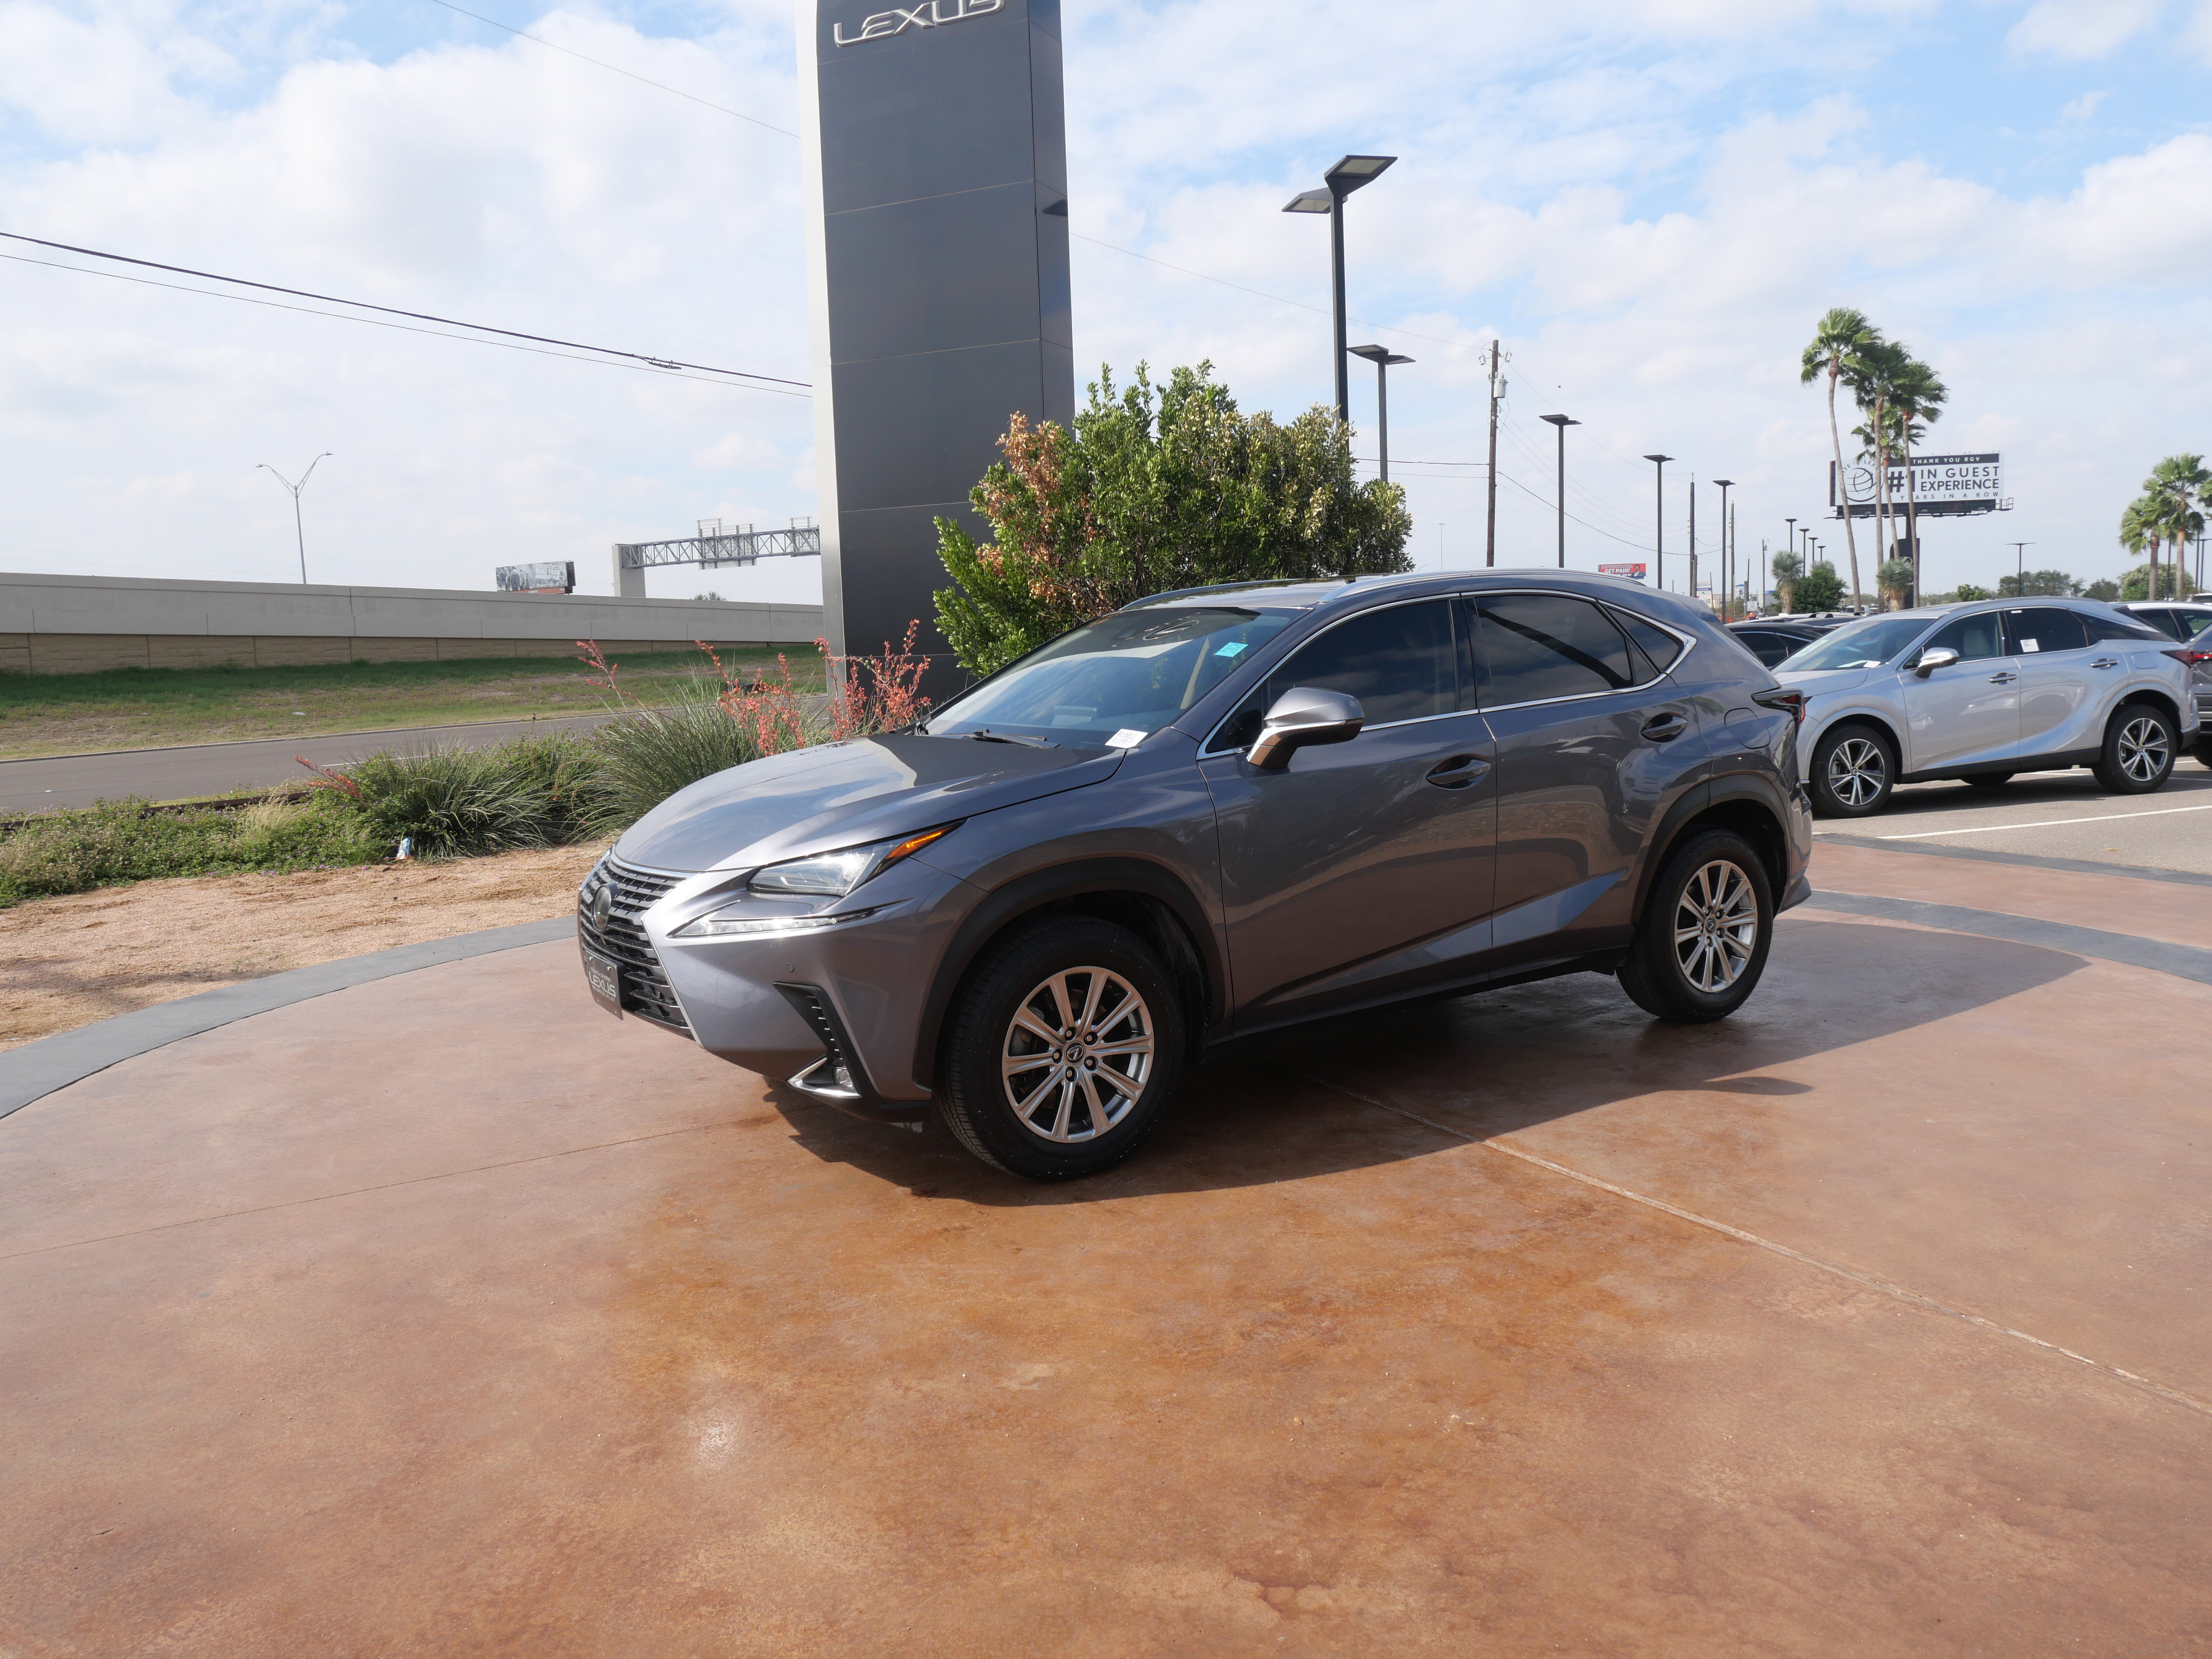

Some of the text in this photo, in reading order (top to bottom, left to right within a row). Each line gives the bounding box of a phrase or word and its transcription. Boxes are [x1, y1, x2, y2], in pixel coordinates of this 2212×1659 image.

[833, 0, 1005, 47] LEXUS
[1921, 466, 1999, 479] IN GUEST
[1921, 479, 1999, 492] EXPERIENCE
[589, 971, 616, 998] LEXUS
[601, 973, 611, 983] PARK
